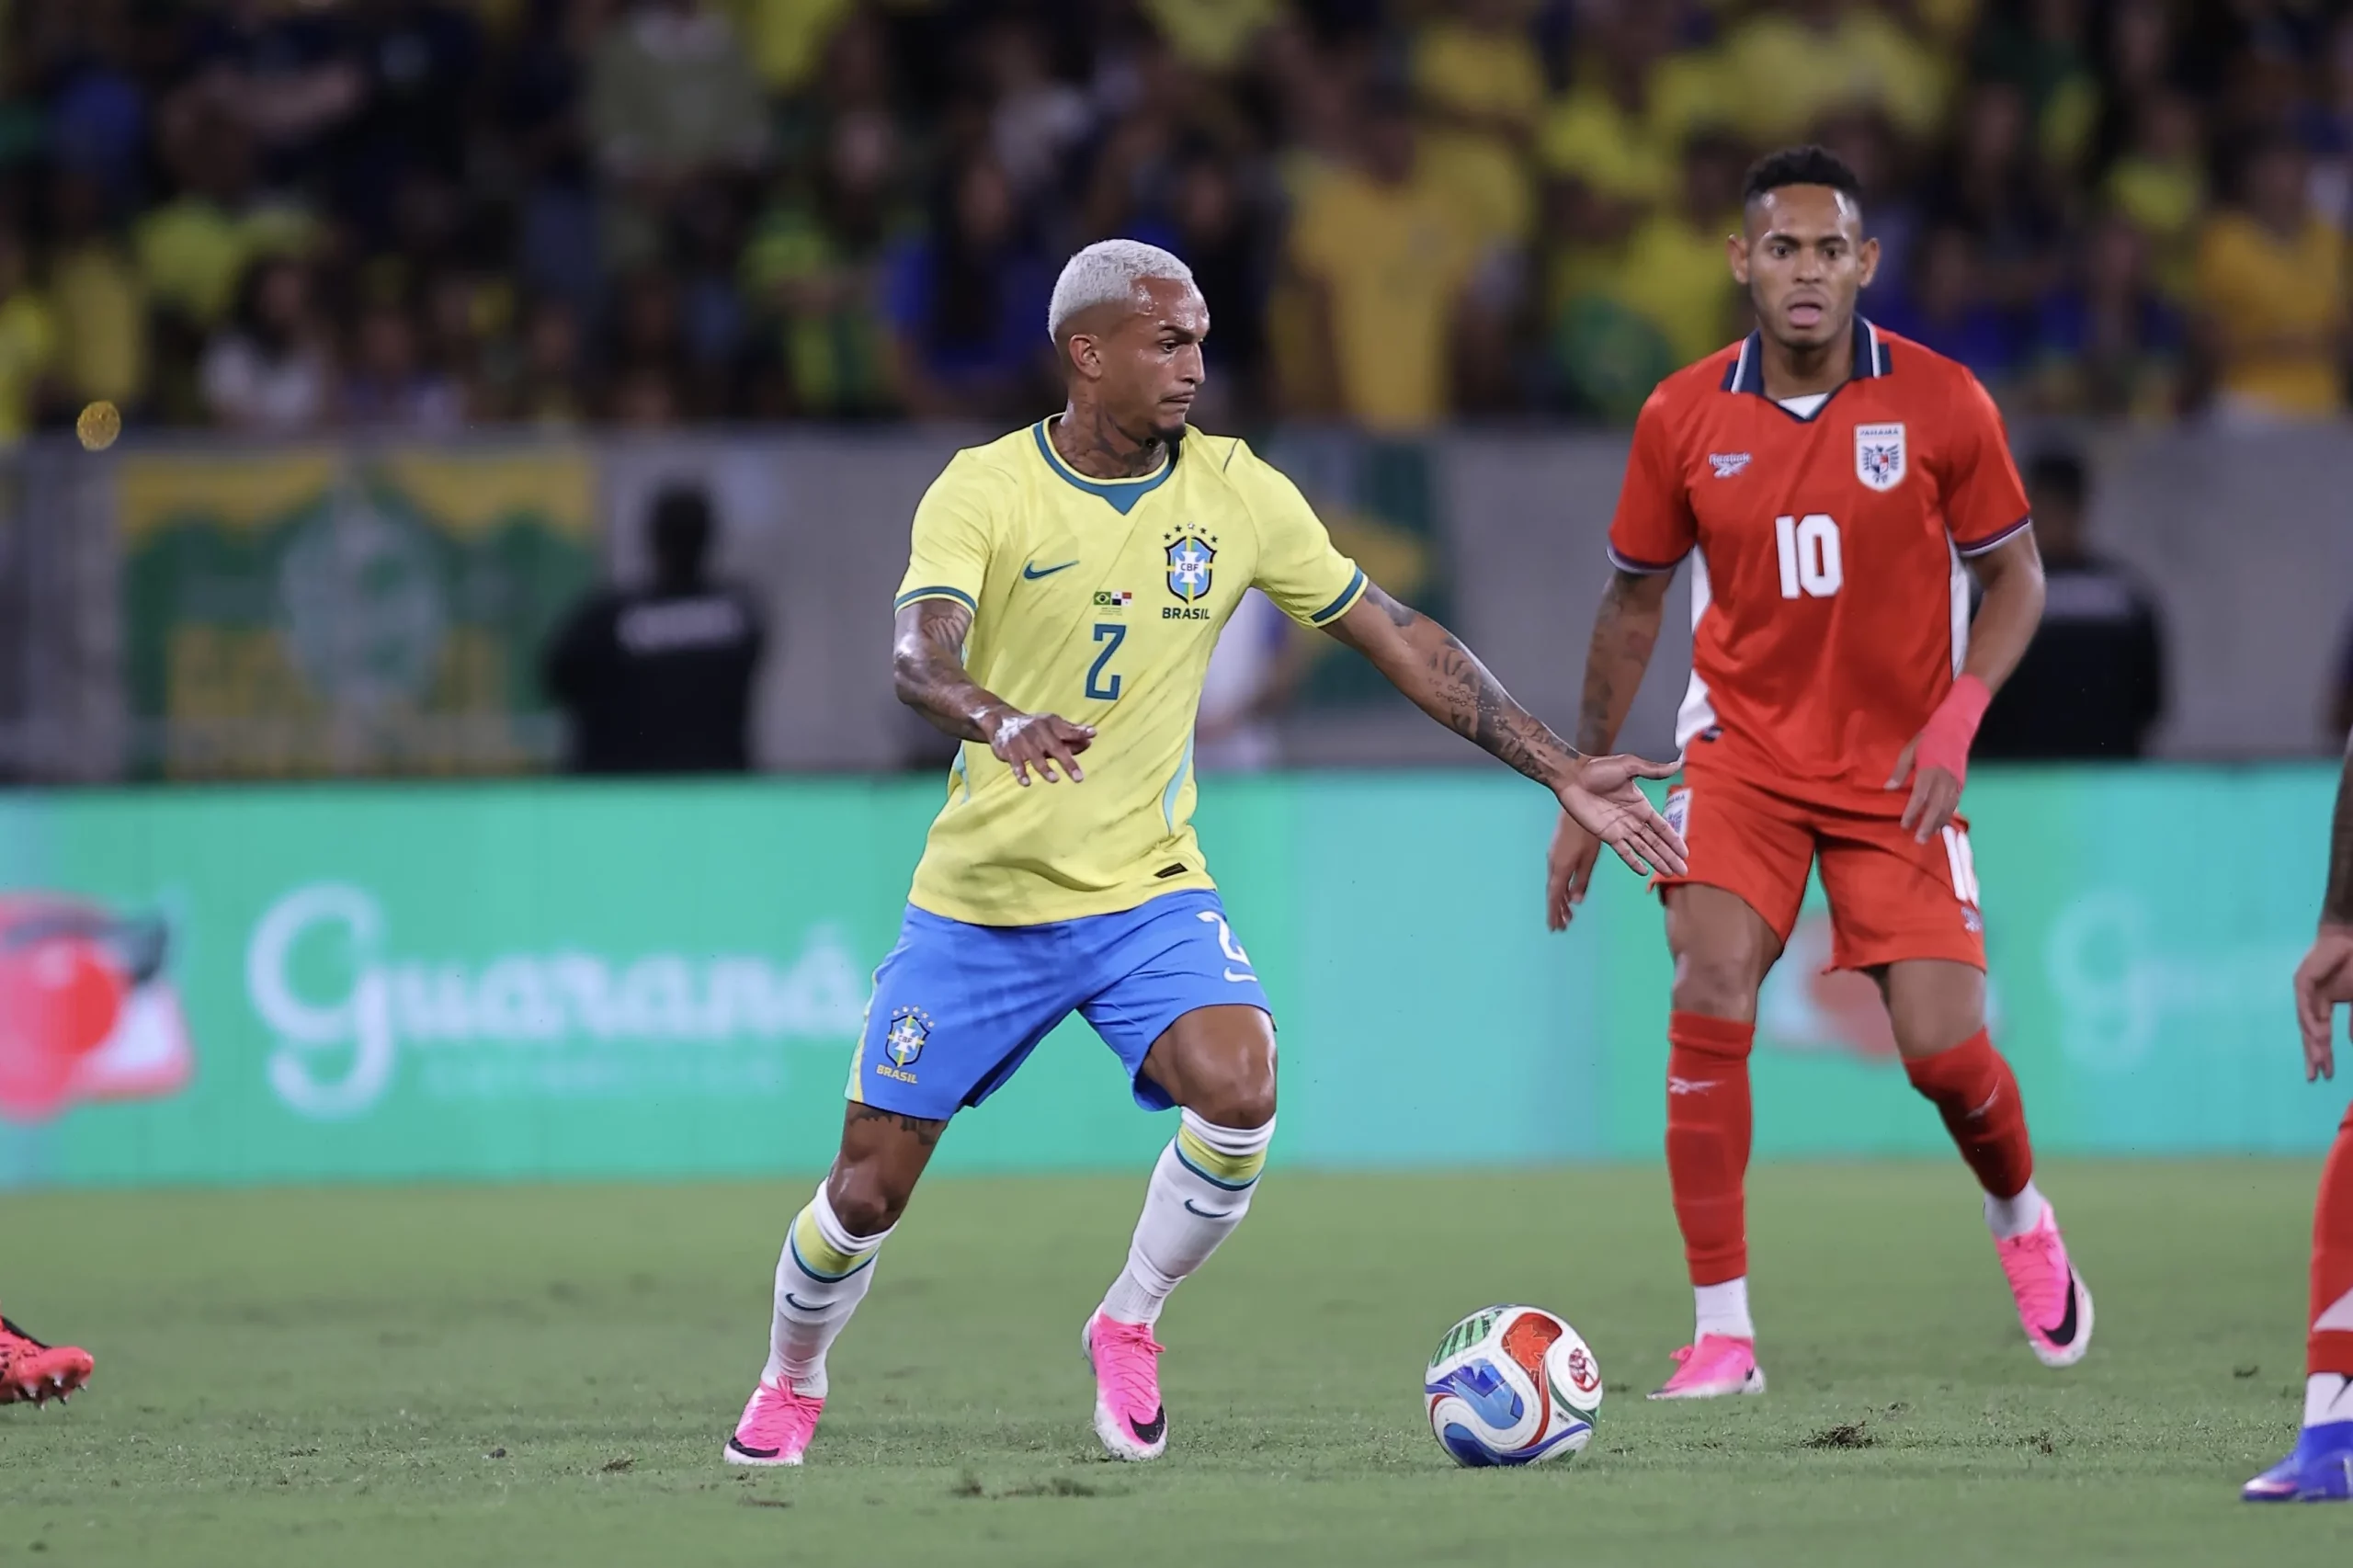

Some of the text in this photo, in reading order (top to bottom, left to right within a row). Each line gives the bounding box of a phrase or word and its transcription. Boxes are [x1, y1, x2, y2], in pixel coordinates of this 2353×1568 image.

[1180, 562, 1199, 572] CBF
[1775, 514, 1844, 599] 10
[1162, 607, 1211, 620] BRASIL
[1085, 623, 1127, 700] 2
[1196, 910, 1252, 968] 2
[876, 1063, 918, 1085] BRASIL
